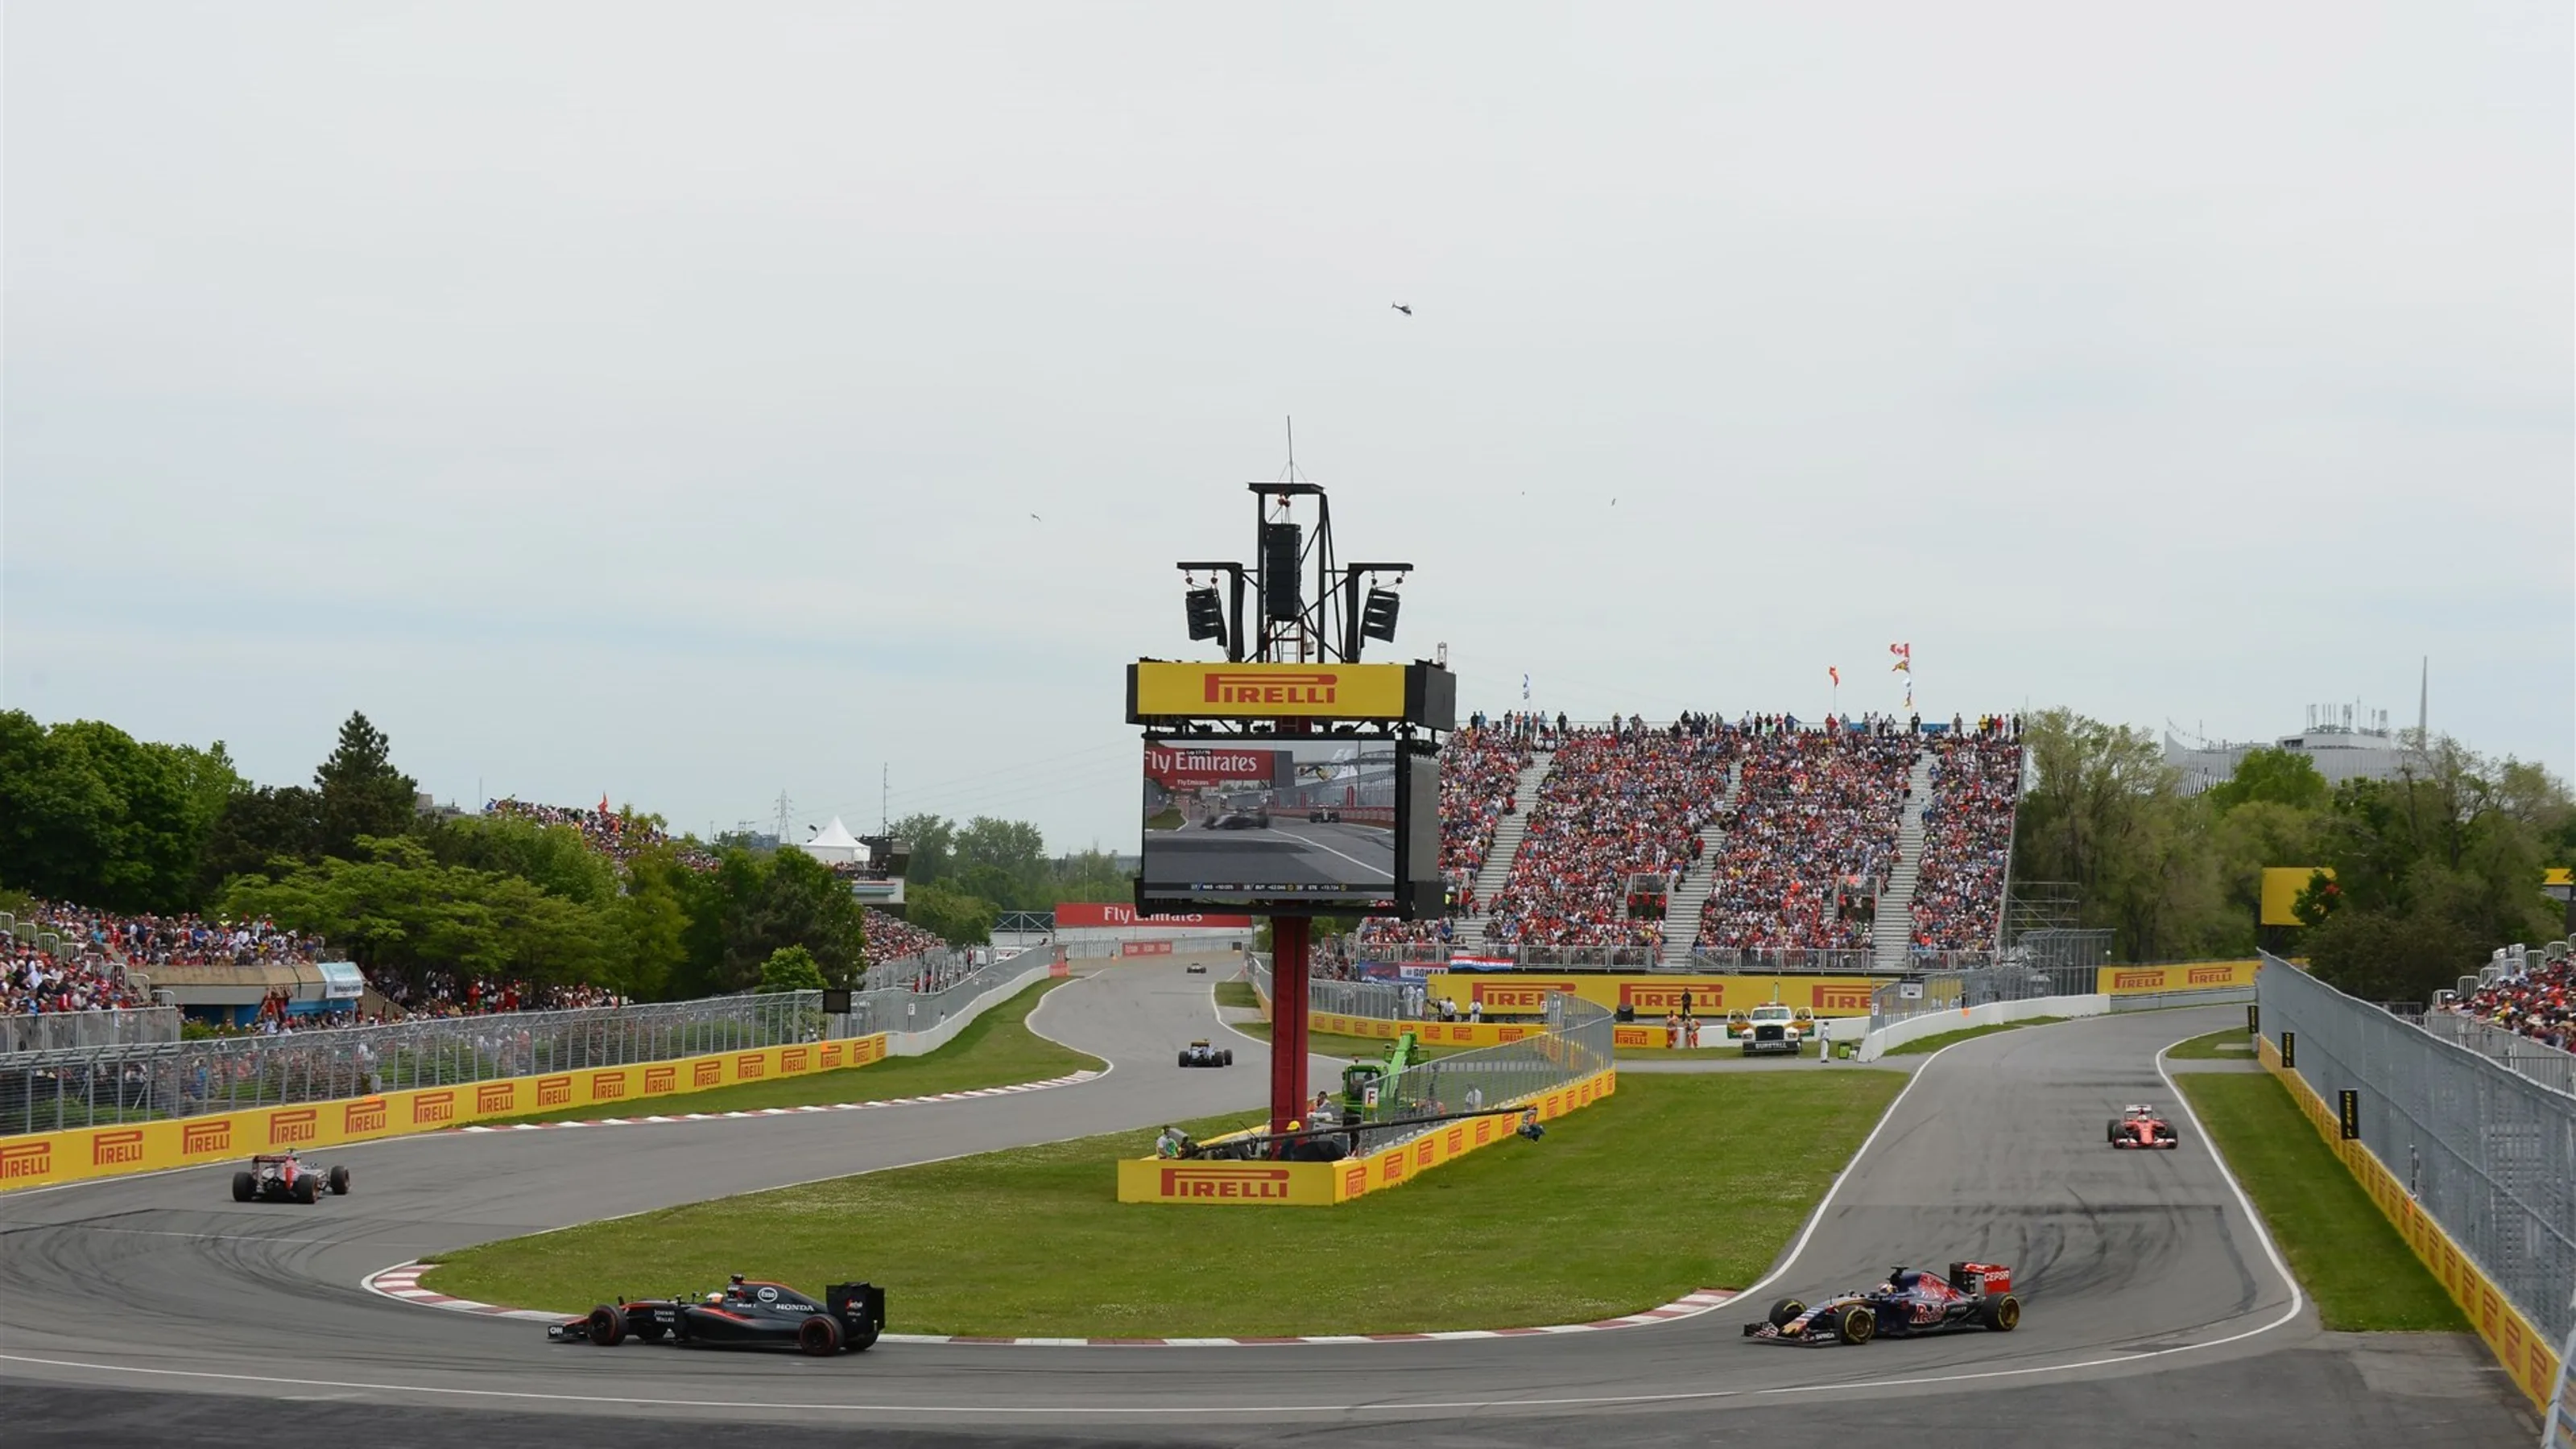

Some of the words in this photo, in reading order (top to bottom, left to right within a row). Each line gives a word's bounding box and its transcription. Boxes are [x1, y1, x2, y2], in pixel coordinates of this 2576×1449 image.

[1205, 674, 1338, 704] PIRELLI
[1104, 906, 1130, 924] Fly
[2115, 971, 2165, 989] PIRELLI
[2189, 967, 2231, 984] PIRELLI
[1472, 983, 1576, 1005] PIRE
[1620, 984, 1723, 1007] PIRELI
[1813, 985, 1882, 1008] PIRE
[1615, 1030, 1648, 1045] PIRELLI
[738, 1054, 764, 1079] PIRELLI
[781, 1048, 807, 1072] PIRELLI
[593, 1072, 625, 1099] PIRELLI
[645, 1067, 675, 1093] PIRELLI
[694, 1061, 722, 1087] PIRELLI
[478, 1083, 514, 1114] PIRELLI
[538, 1076, 571, 1106] PIRELLI
[1368, 1091, 1375, 1104] F
[345, 1100, 387, 1134] PIRELLI
[413, 1091, 454, 1124] PIRELLI
[183, 1120, 230, 1154] PIRELLI
[270, 1109, 316, 1145] PIRELLI
[93, 1130, 143, 1166] PIRELLI
[1383, 1152, 1403, 1181] PIRELLI
[1161, 1168, 1290, 1197] PIRELLI
[1346, 1166, 1367, 1196] PIRELLI
[1984, 1271, 2010, 1282] CEPSA
[776, 1303, 814, 1311] HONDA
